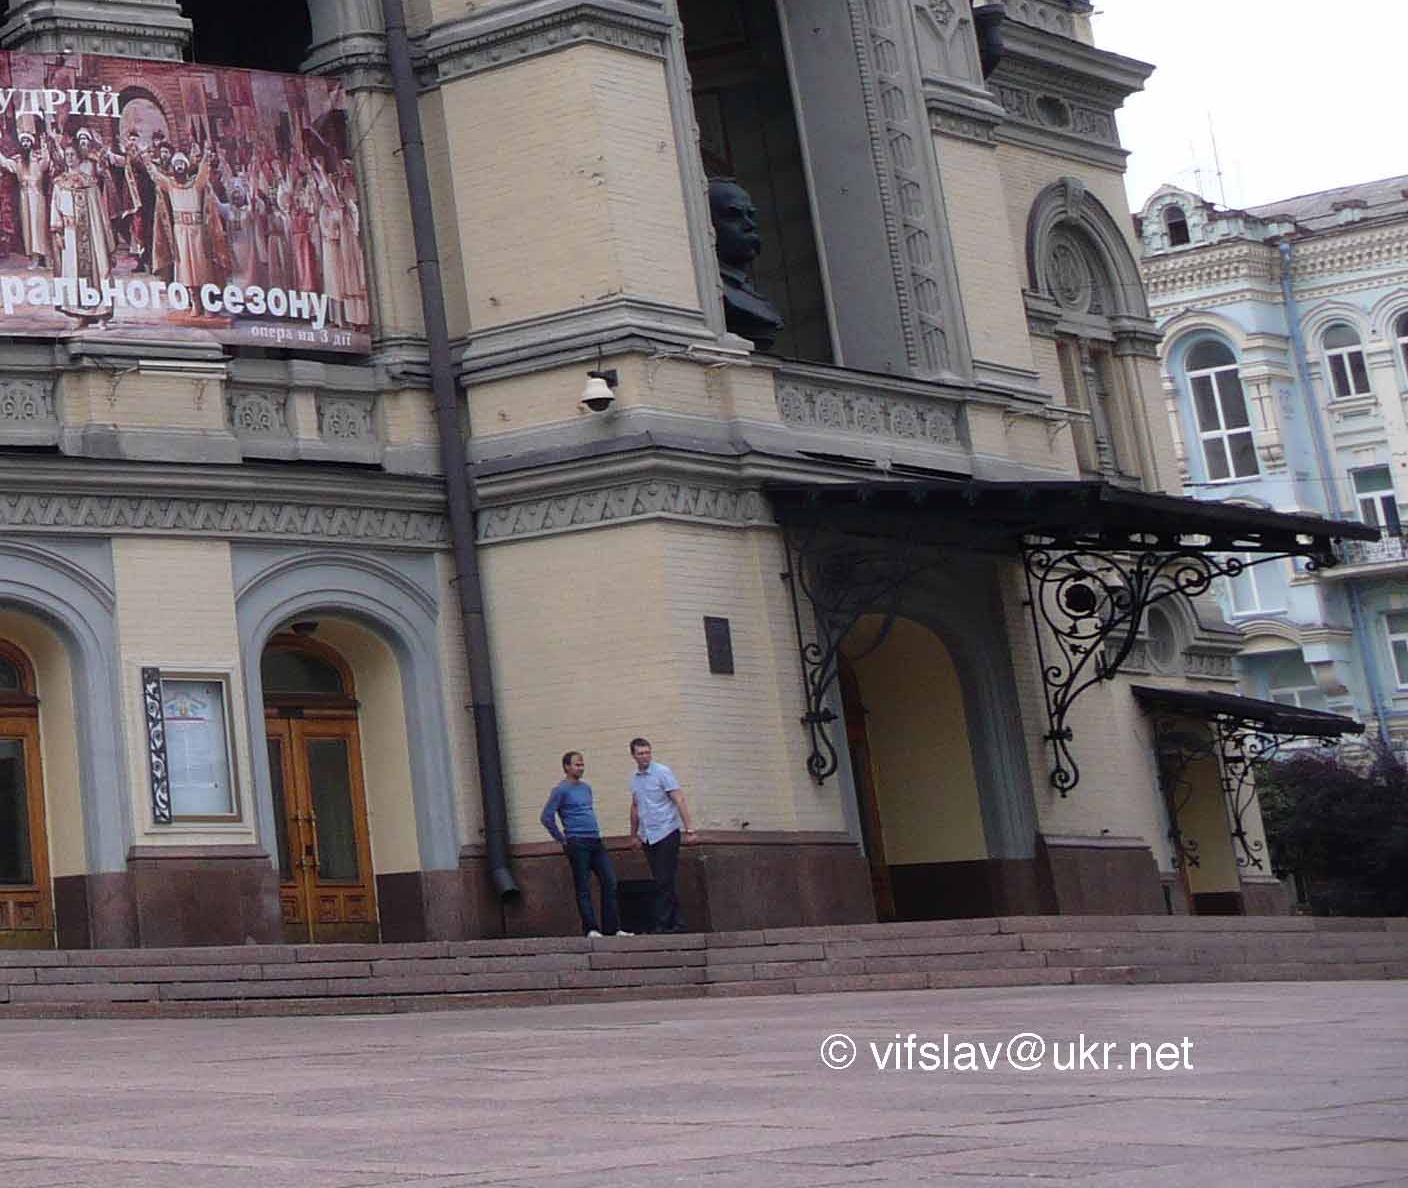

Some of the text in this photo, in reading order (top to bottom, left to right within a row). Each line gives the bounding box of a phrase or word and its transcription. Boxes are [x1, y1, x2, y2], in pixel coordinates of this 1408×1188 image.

[200, 282, 329, 330] сезону
[251, 326, 352, 346] опера на 3 дії
